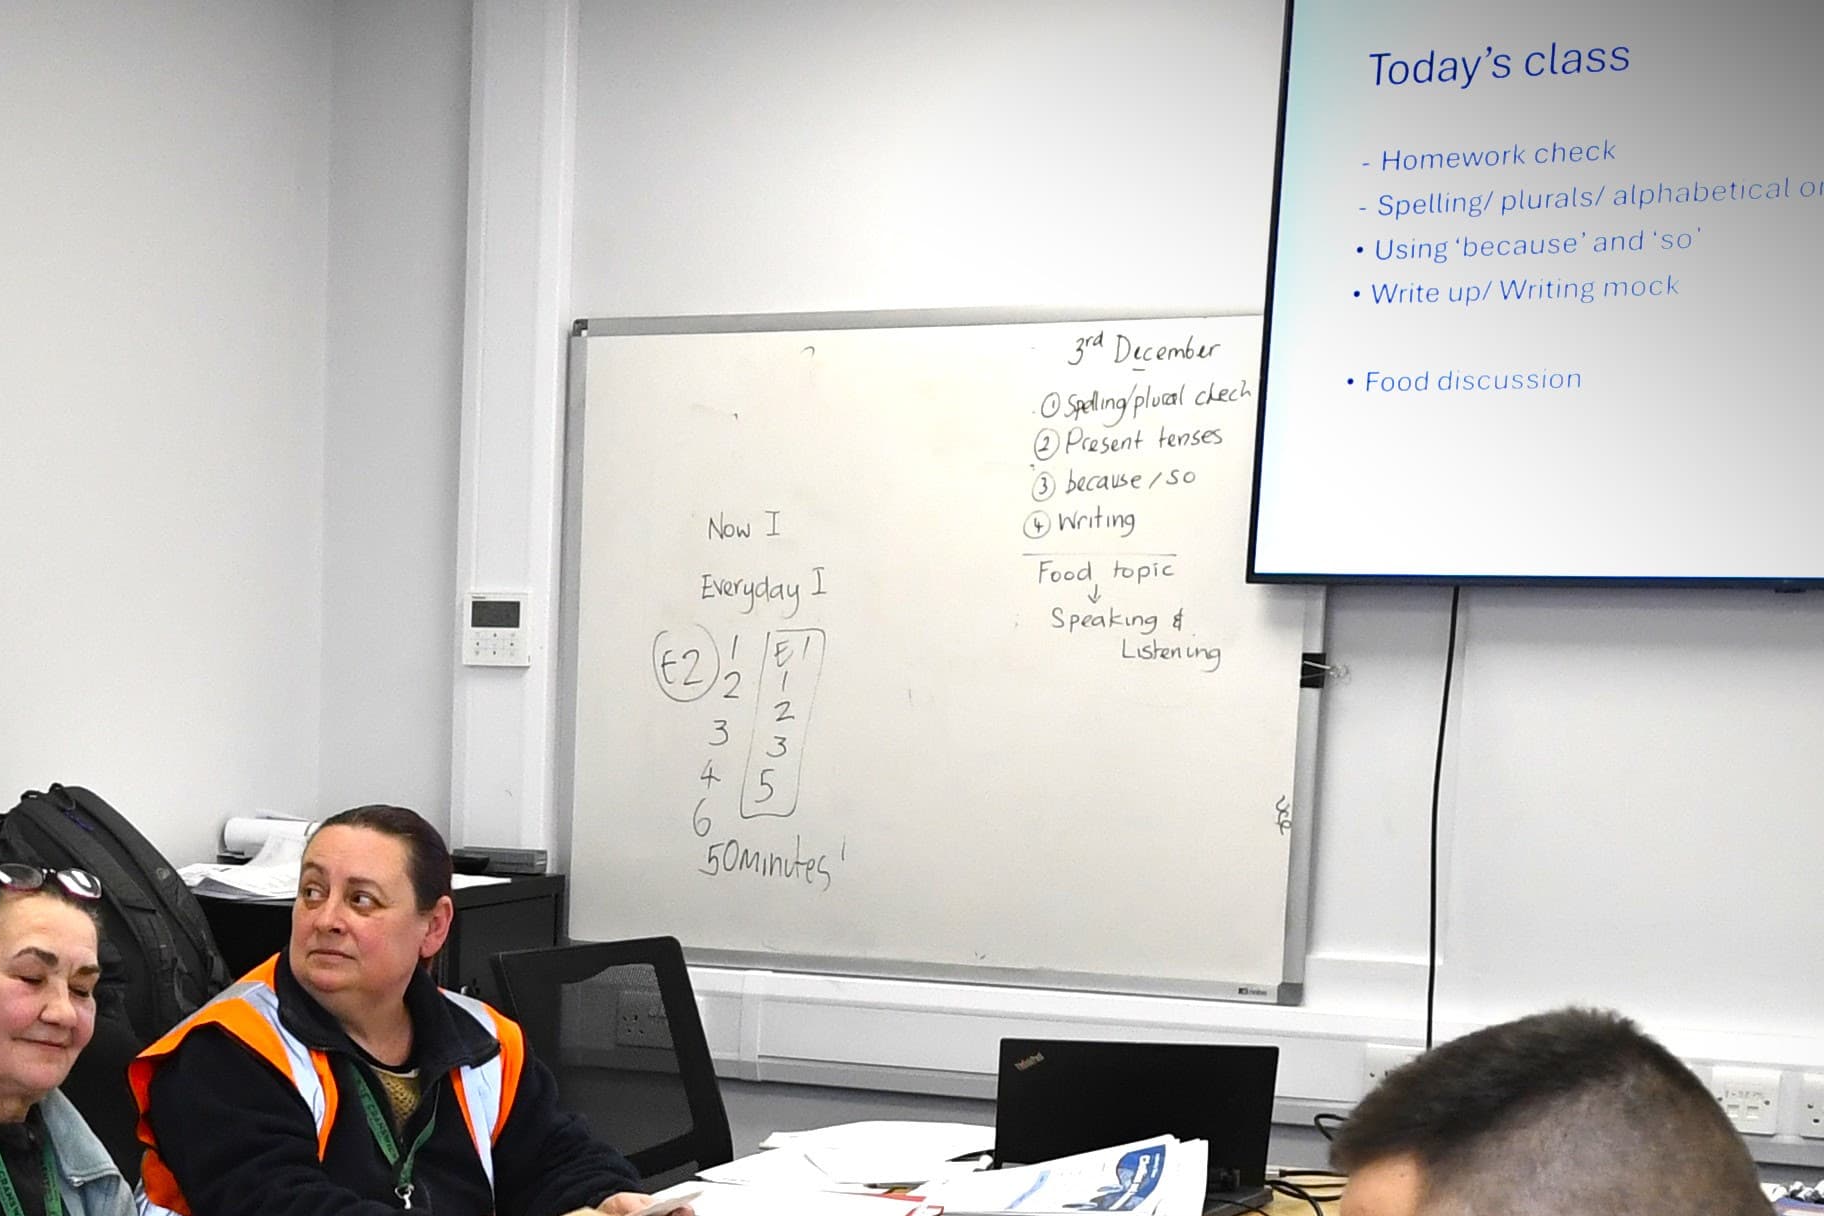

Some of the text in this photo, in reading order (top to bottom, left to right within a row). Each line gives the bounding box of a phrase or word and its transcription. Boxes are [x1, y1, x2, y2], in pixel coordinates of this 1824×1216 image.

[1369, 42, 1630, 90] Today's class
[1382, 139, 1616, 172] Homework check
[1378, 190, 1494, 221] Spelling/
[1501, 185, 1605, 217] plurals/
[1613, 177, 1790, 210] alphabetical
[1375, 227, 1702, 264] Using 'because' and 'so'
[1371, 275, 1681, 307] Write up/ Writing mock
[1068, 330, 1220, 365] 3rd December
[1366, 368, 1582, 393] Food discussion
[1066, 426, 1144, 454] Present
[1159, 425, 1223, 448] tenses
[1065, 469, 1142, 494] because
[708, 510, 781, 540] Now I
[1059, 505, 1136, 538] Writing
[1039, 560, 1175, 584] Food topic
[702, 566, 827, 619] Everyday I
[1051, 607, 1158, 636] Speaking
[1121, 638, 1221, 673] Listening
[723, 671, 741, 698] 2
[774, 701, 795, 722] 2
[708, 719, 729, 746] 3
[766, 736, 787, 758] 3
[700, 759, 721, 790] 4
[755, 768, 775, 804] 5
[693, 798, 712, 837] 6
